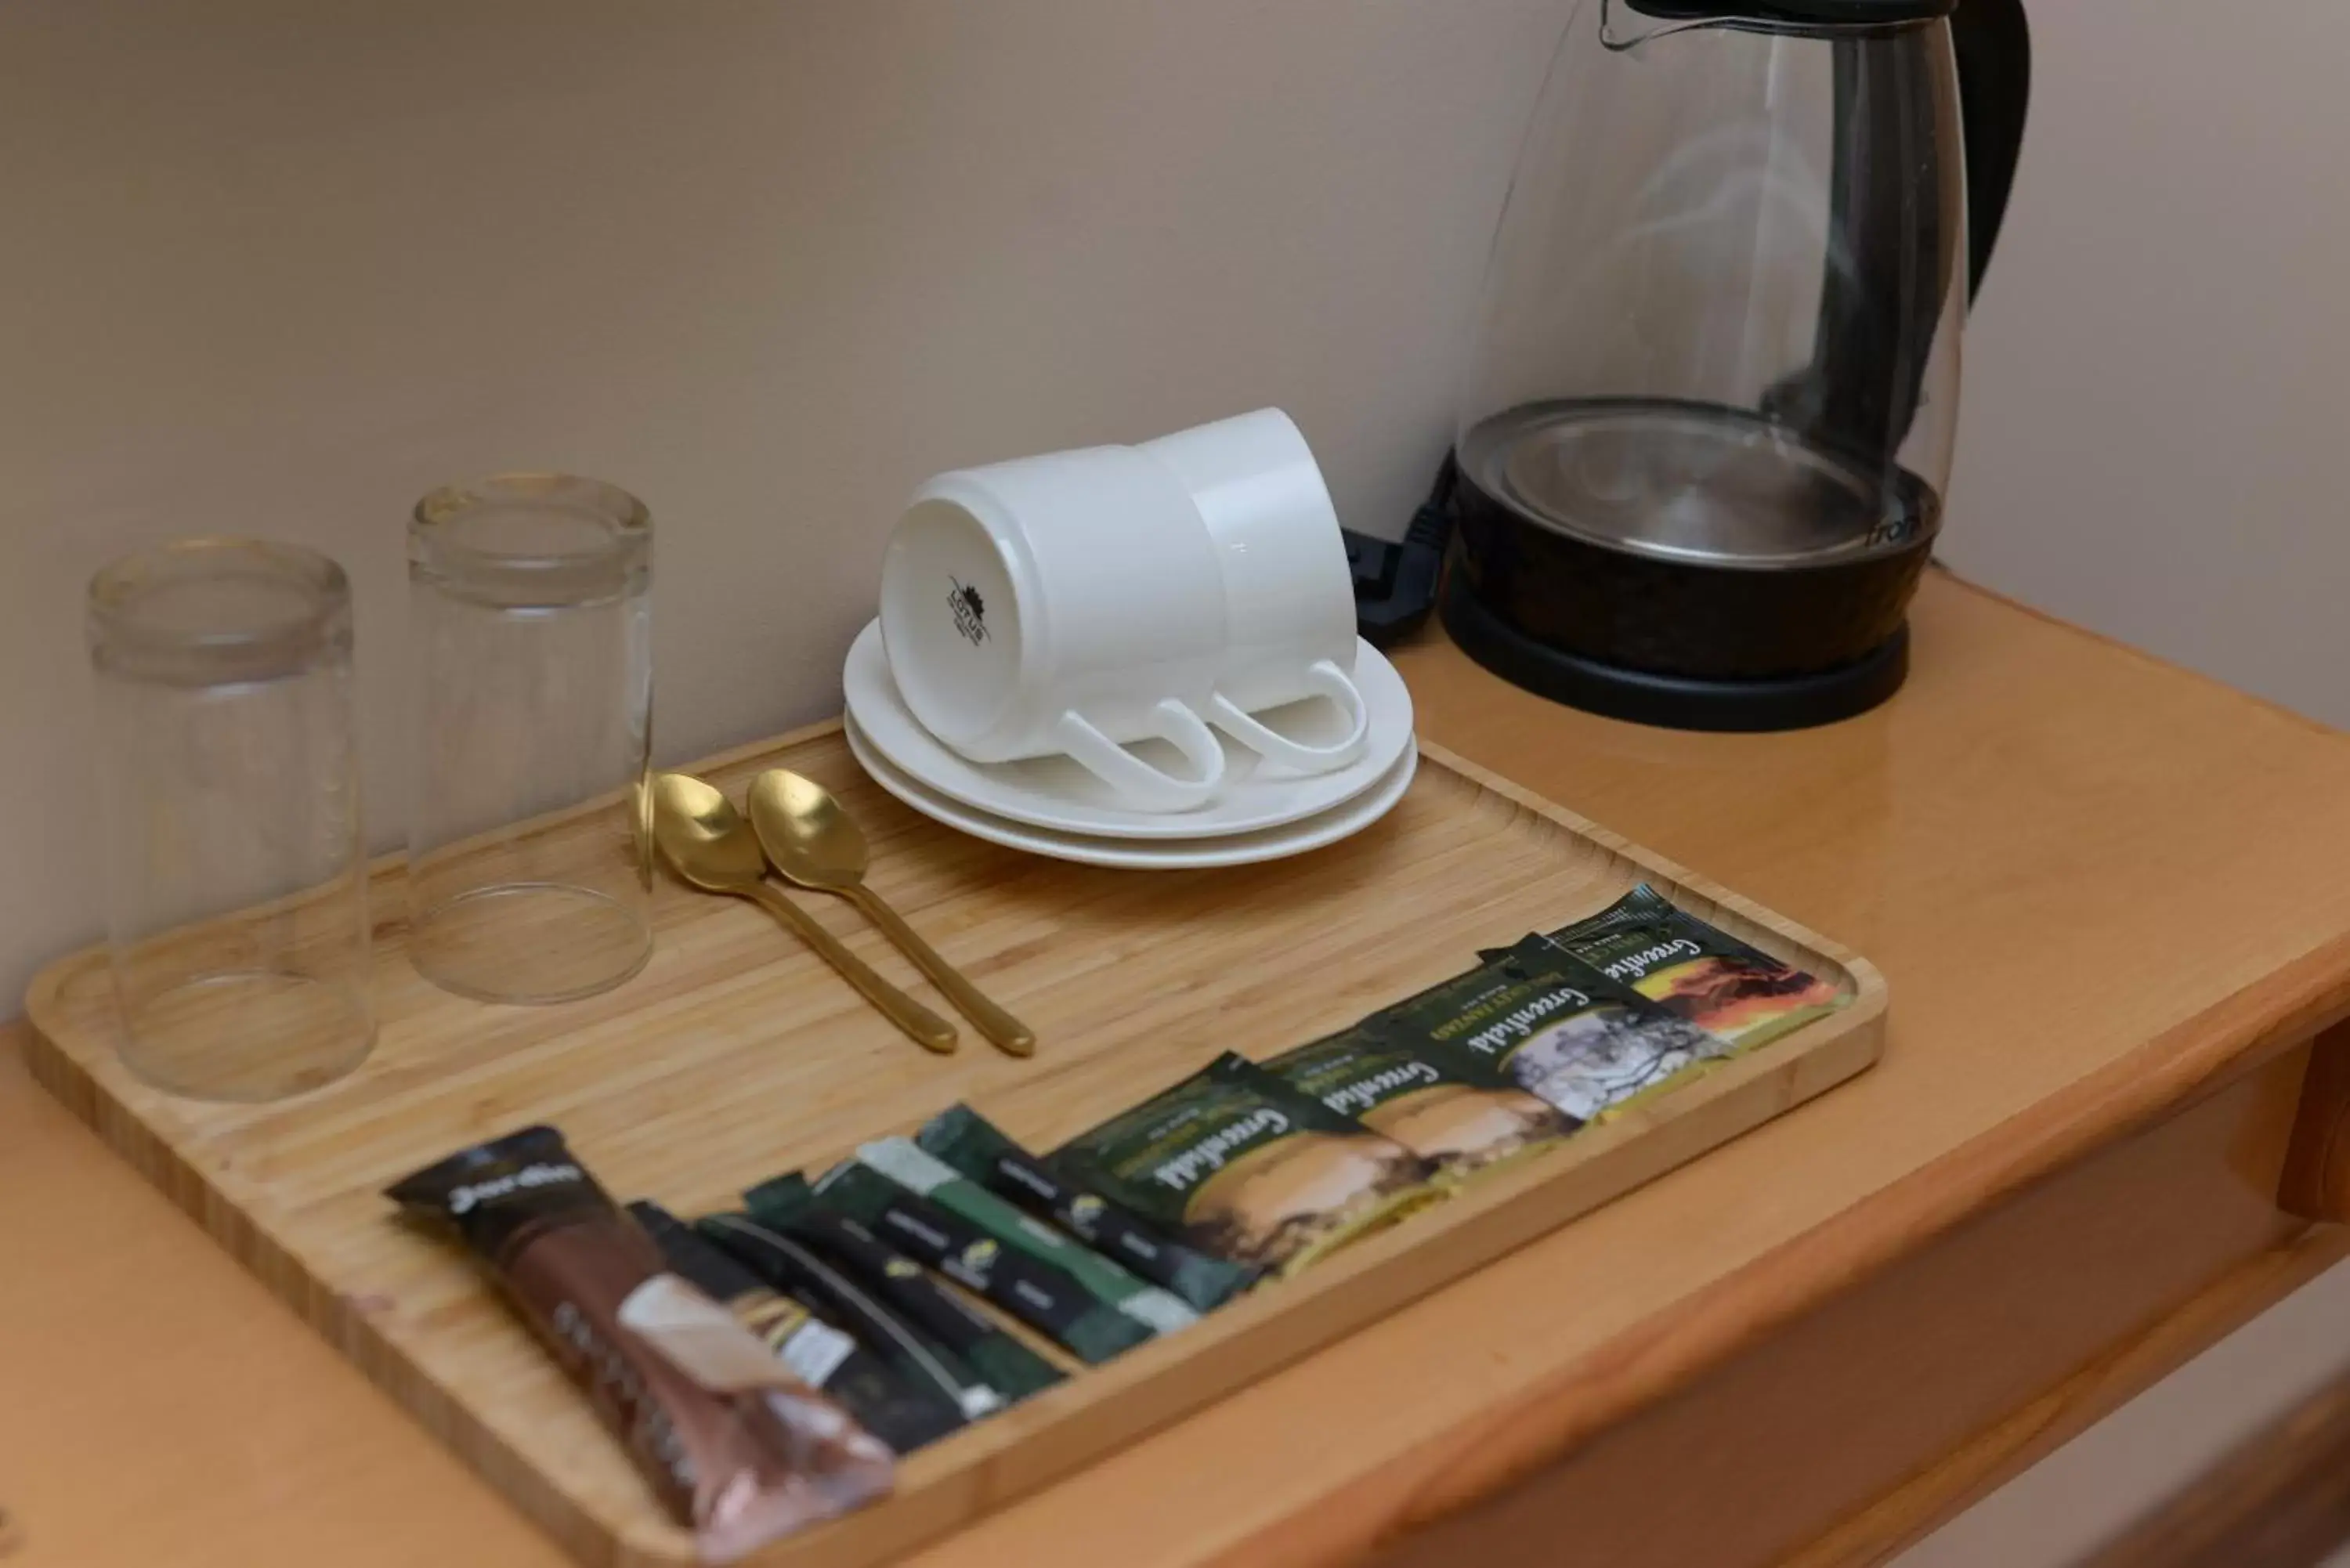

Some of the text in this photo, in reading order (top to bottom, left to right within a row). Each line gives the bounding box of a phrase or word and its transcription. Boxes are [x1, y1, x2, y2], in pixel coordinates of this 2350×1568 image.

[1605, 939, 1701, 982] Greenfie
[1467, 988, 1589, 1053] Greenfield
[1322, 1061, 1439, 1116] Greenfiel
